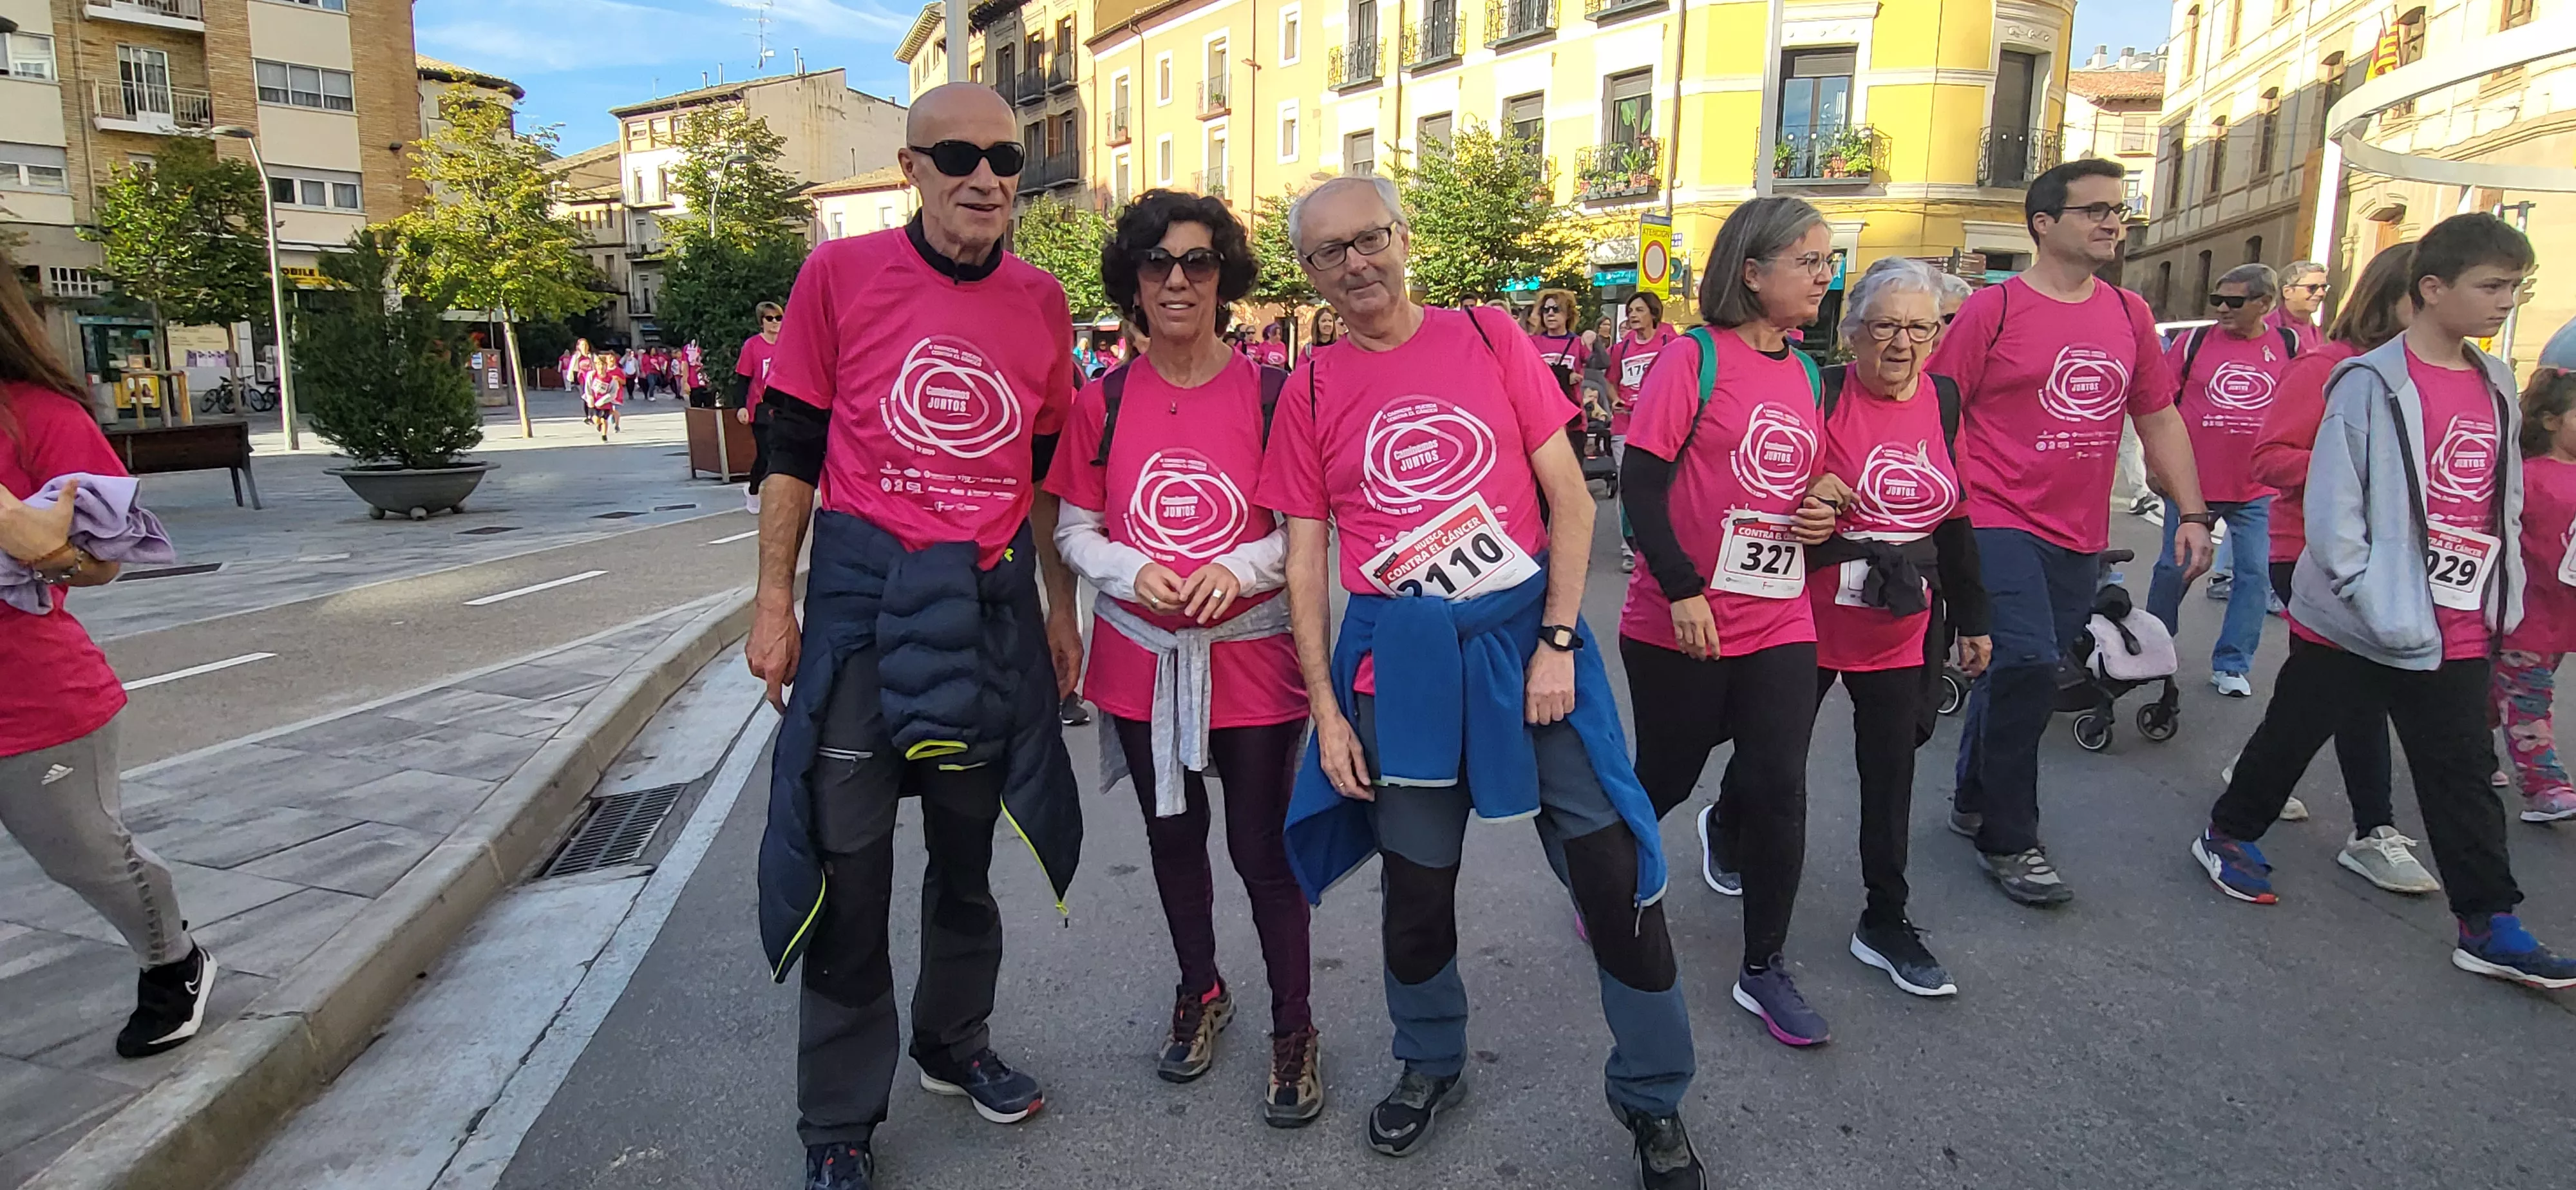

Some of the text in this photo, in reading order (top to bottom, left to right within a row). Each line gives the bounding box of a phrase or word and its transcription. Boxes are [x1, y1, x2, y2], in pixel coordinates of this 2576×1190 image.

[281, 267, 315, 276] OBILE
[927, 397, 966, 412] JUNTOS
[1400, 450, 1439, 471] JUNTOS
[1764, 451, 1792, 462] JUNTOS
[1885, 486, 1915, 496] JUNTOS
[1163, 505, 1196, 518] JUNTOS
[1739, 527, 1774, 539] CONTRA
[1414, 529, 1445, 552] HUESCA
[1387, 551, 1430, 581] CONTRA
[1428, 543, 1443, 556] EL
[1442, 516, 1482, 546] CÁNCER
[1740, 542, 1796, 575] 327
